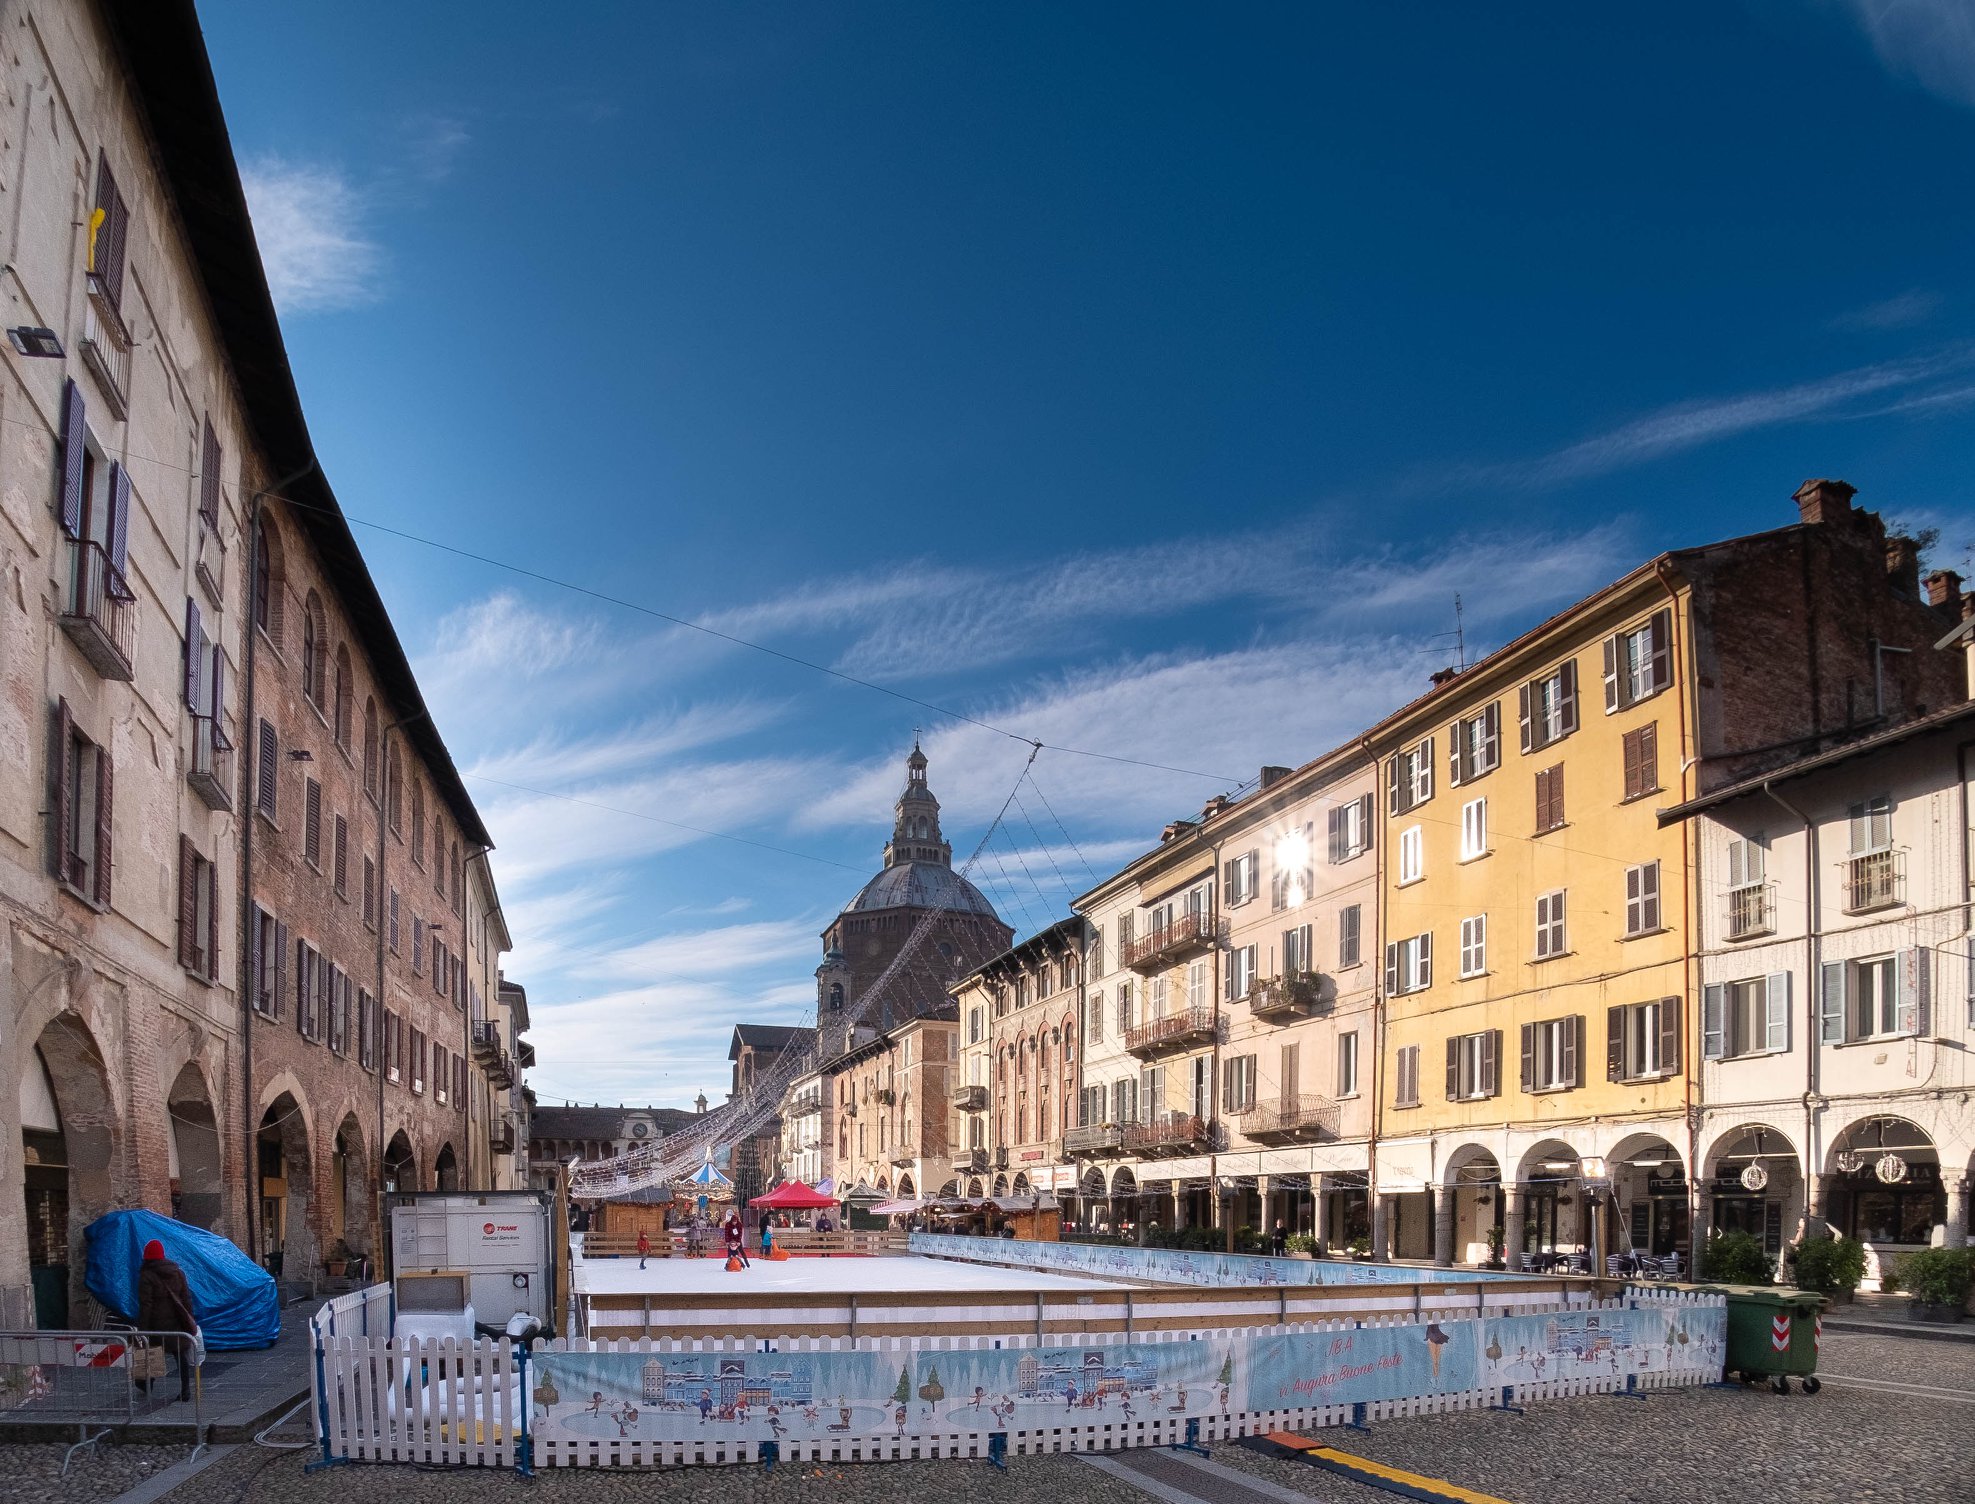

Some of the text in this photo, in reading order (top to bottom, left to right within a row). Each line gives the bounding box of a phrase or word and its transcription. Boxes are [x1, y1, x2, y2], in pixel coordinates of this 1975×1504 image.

[1293, 1373, 1336, 1398] Augura
[1339, 1364, 1374, 1381] Buone
[1377, 1351, 1404, 1370] Feste
